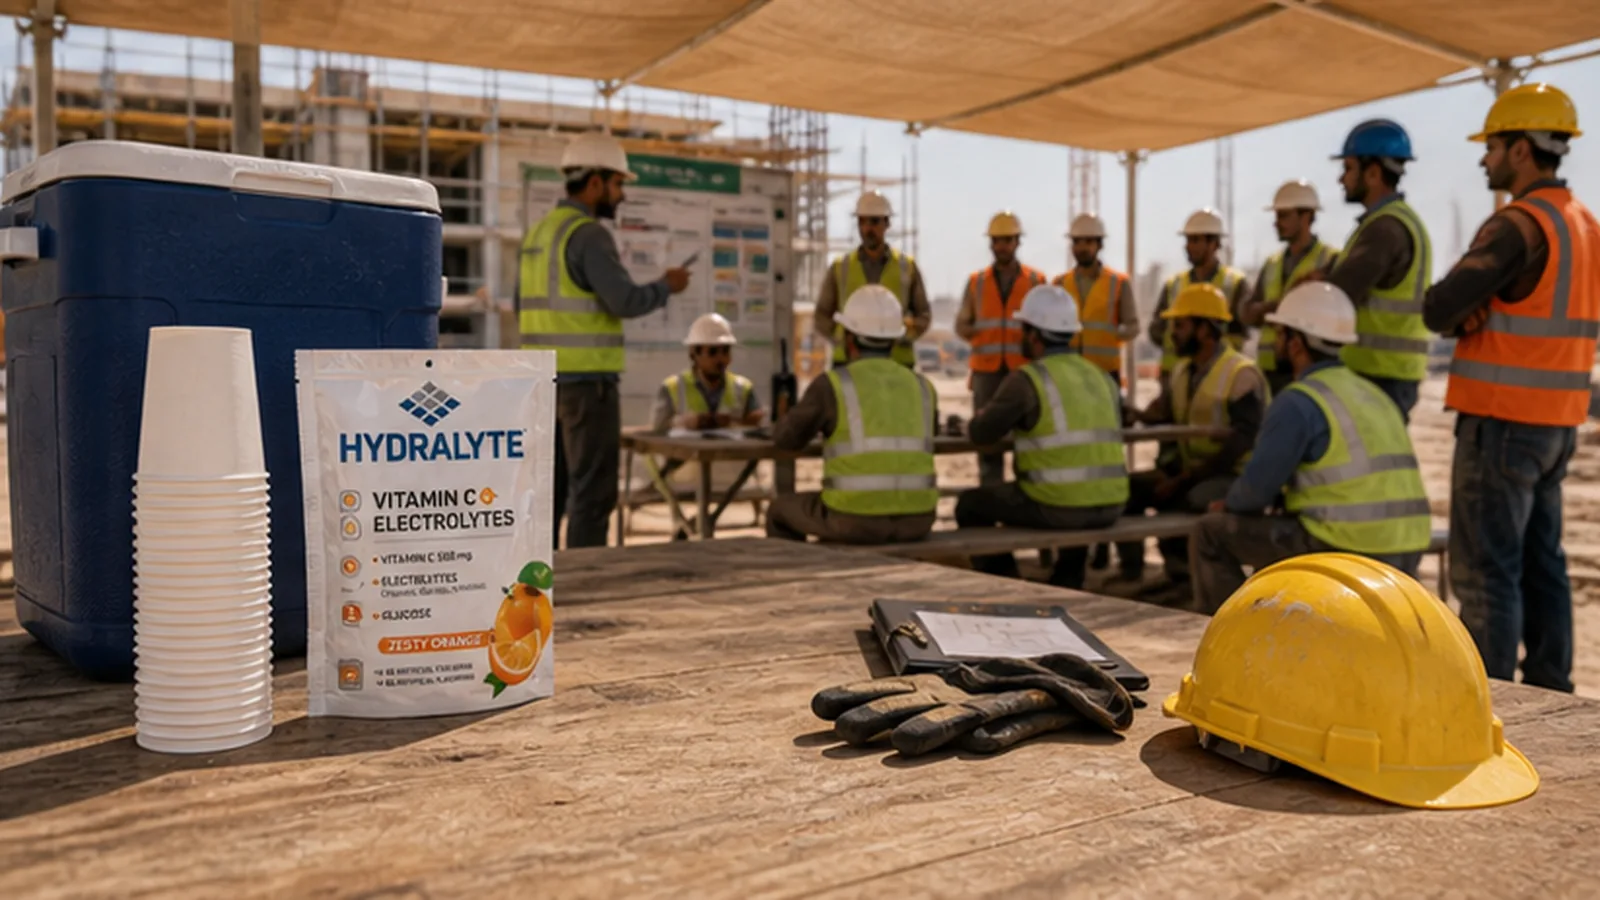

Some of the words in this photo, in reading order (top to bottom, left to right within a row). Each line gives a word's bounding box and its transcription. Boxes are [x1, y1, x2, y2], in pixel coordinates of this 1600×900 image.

[340, 430, 524, 462] HYDRALYTE
[373, 490, 458, 509] VITAMIN
[464, 488, 477, 505] C
[373, 510, 515, 532] ELECTROLYTES
[427, 552, 435, 563] C
[388, 638, 429, 651] ZESTY
[431, 634, 482, 648] ORANGE
